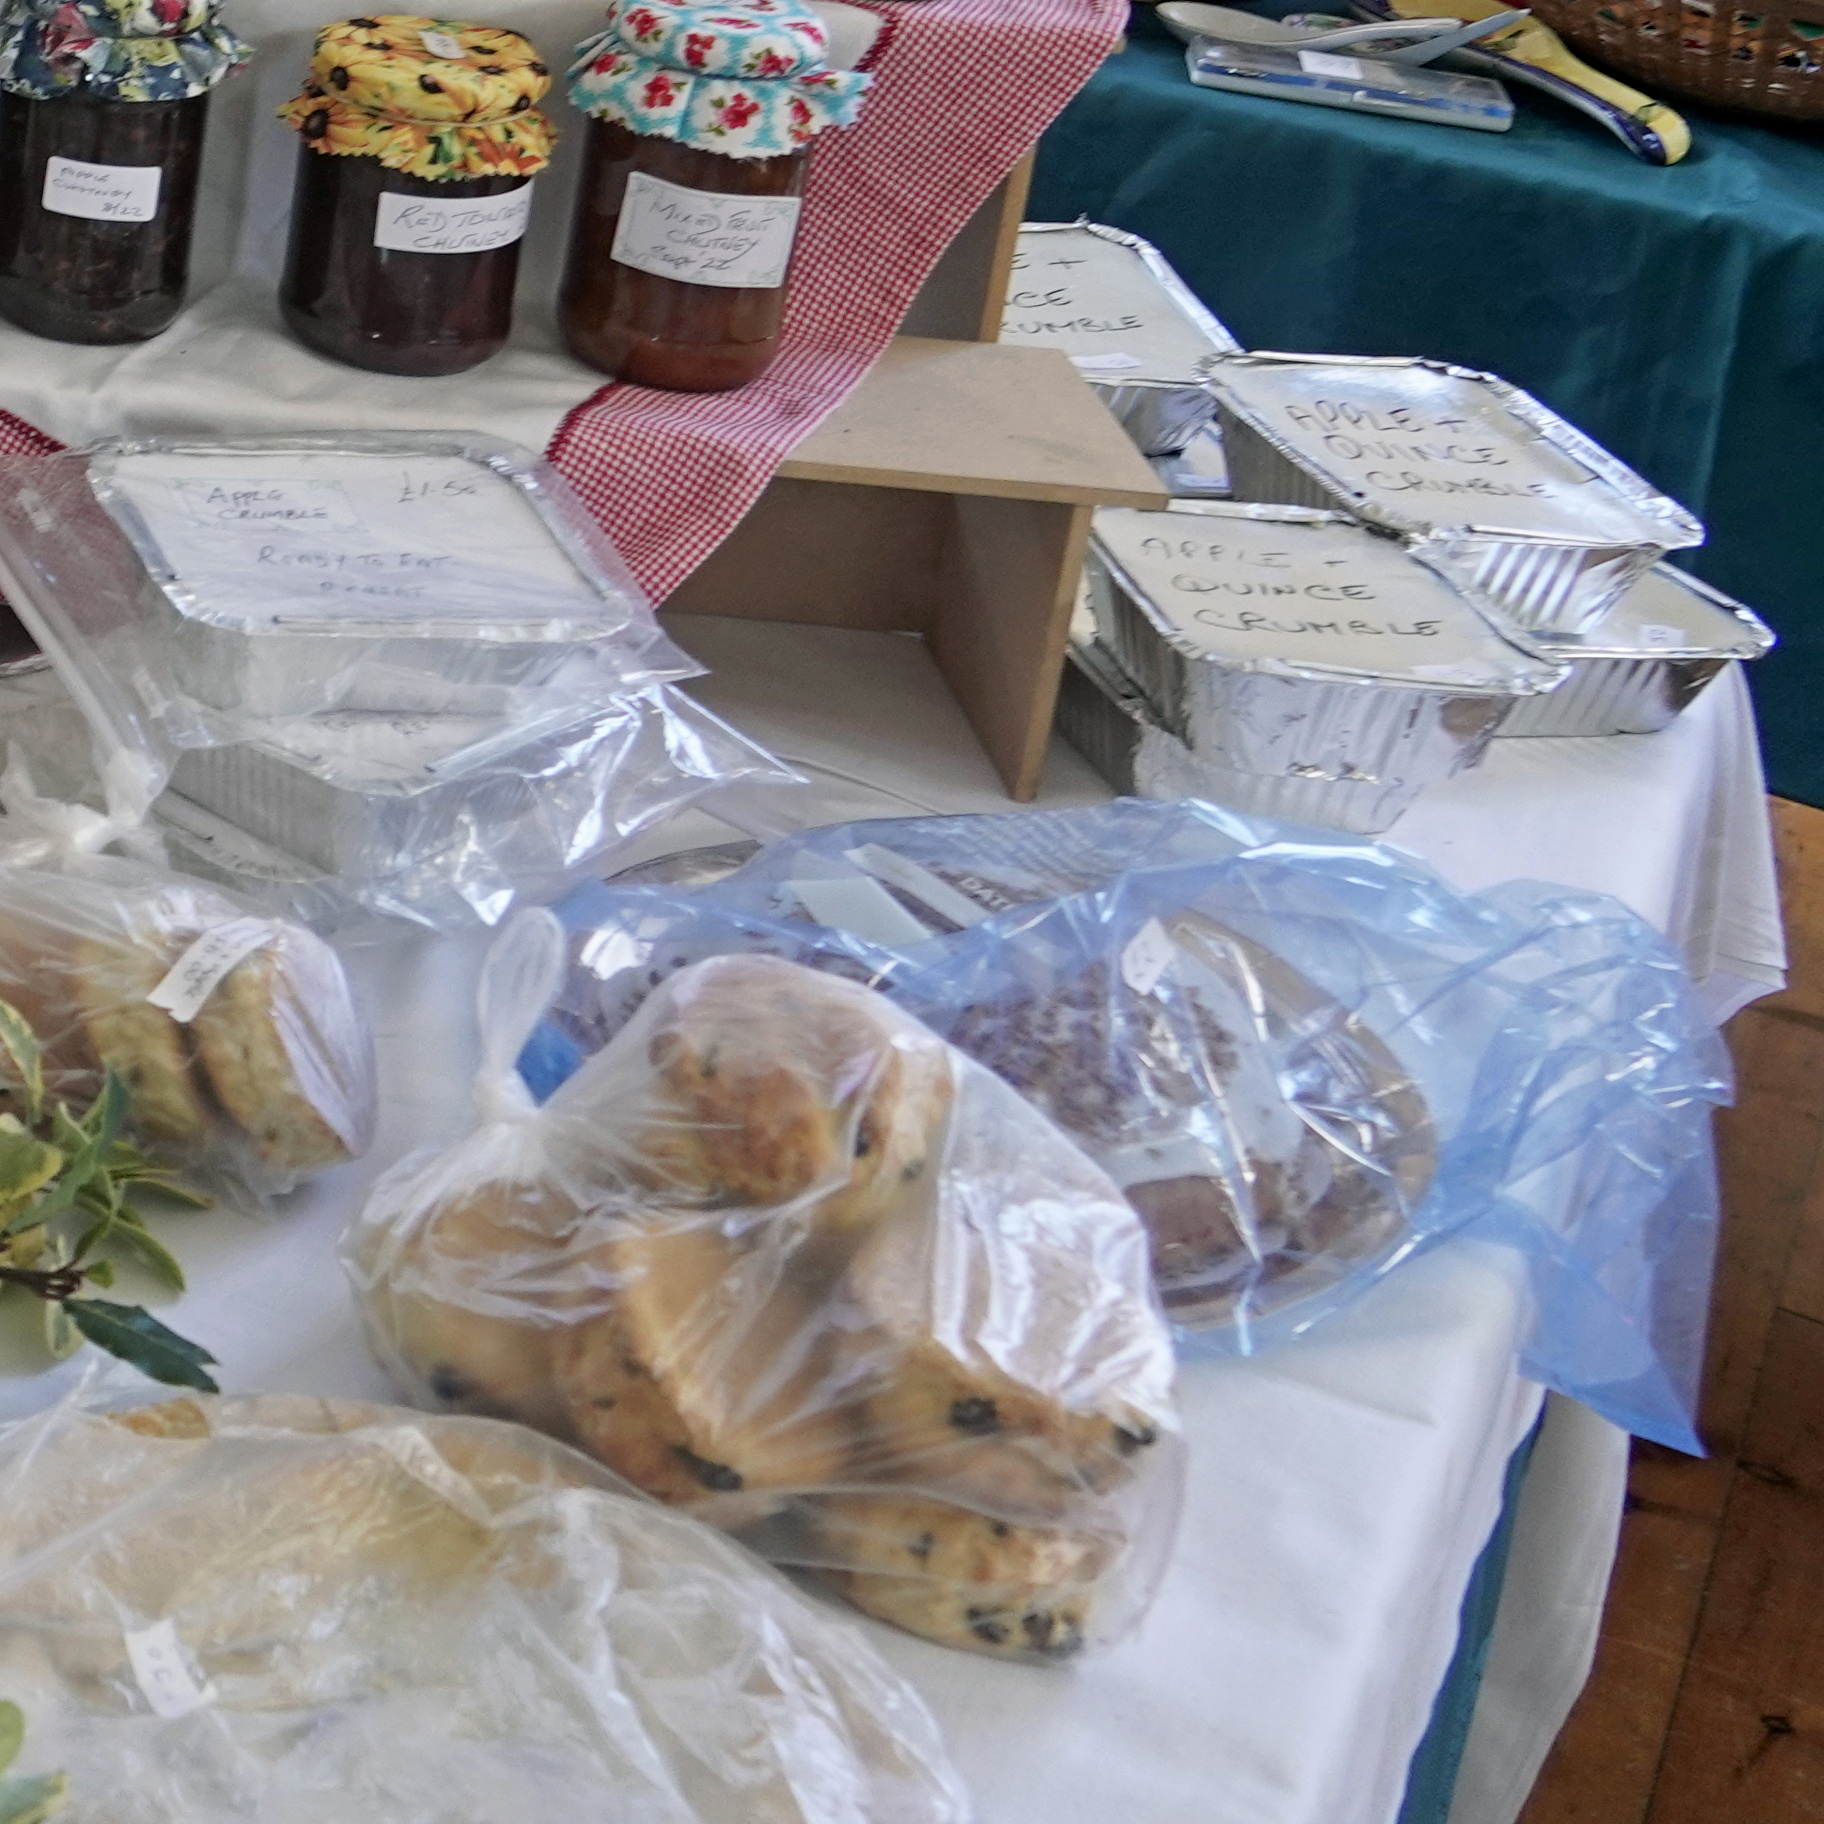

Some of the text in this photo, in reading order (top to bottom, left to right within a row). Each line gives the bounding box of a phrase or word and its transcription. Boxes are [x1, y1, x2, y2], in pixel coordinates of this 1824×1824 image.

[1323, 433, 1509, 467] QUINCE
[1170, 572, 1376, 602] QUINCE
[1191, 608, 1444, 637] CRUMBLE
